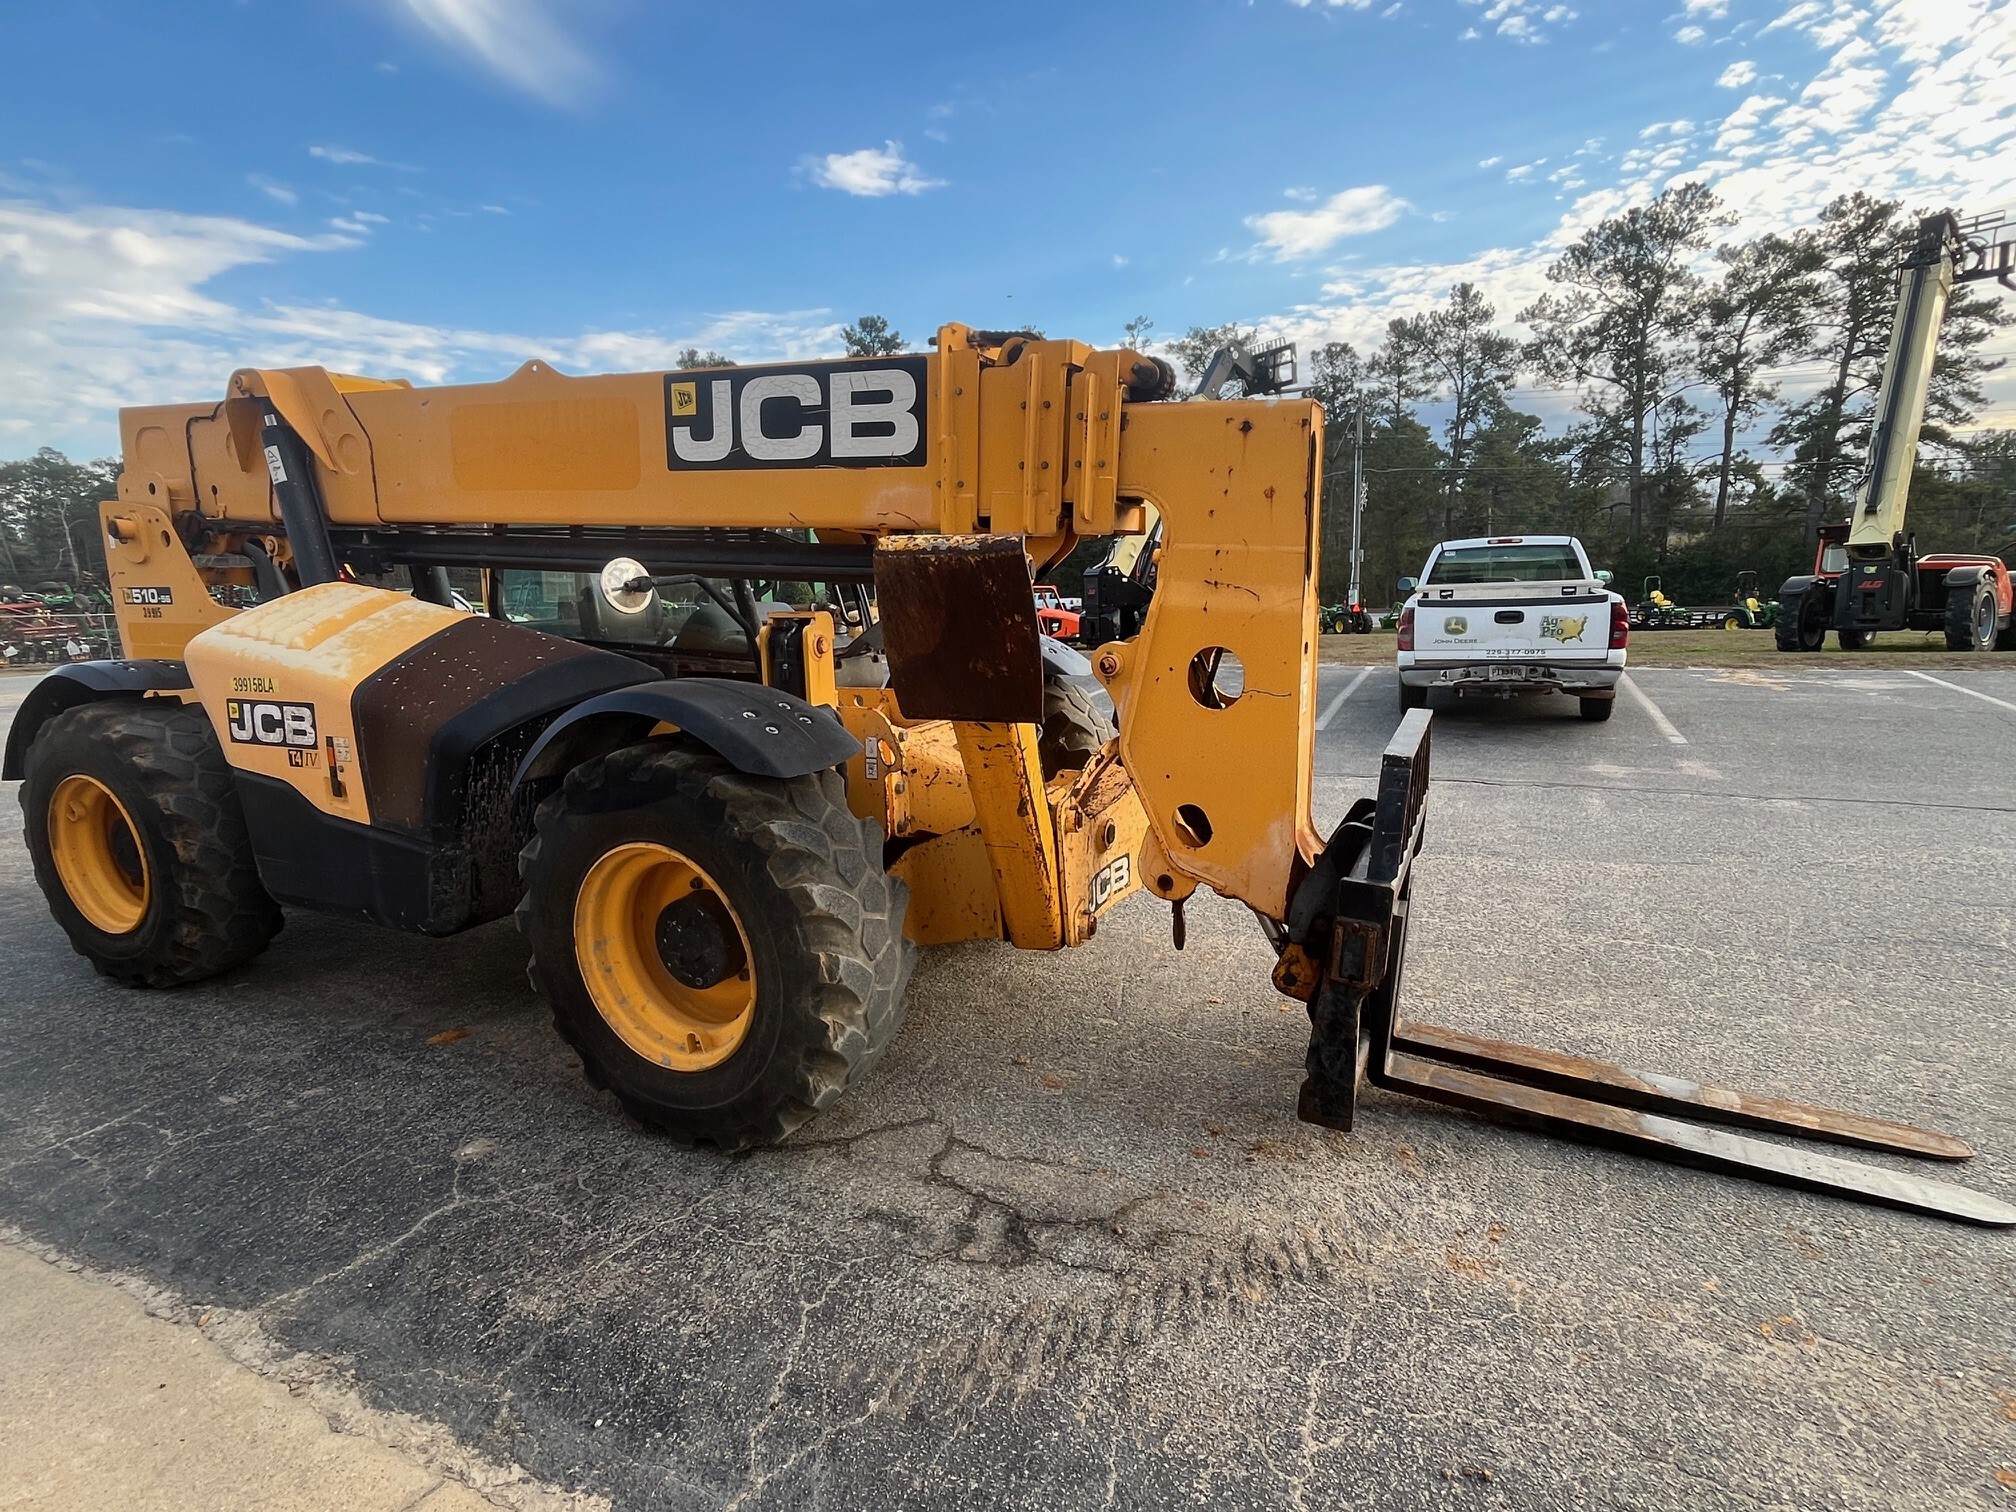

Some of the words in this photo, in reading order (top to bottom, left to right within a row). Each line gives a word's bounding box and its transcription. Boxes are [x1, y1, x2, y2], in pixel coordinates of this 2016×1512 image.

[676, 391, 693, 407] JCB
[673, 369, 919, 462] JCB
[1541, 616, 1563, 627] Ag-
[1541, 626, 1563, 637] Pro
[1441, 671, 1448, 679] 4
[233, 677, 274, 692] 39915BLA
[231, 703, 316, 746] JCB
[290, 751, 302, 766] T4
[305, 752, 317, 766] IV
[1089, 856, 1129, 912] JCB
